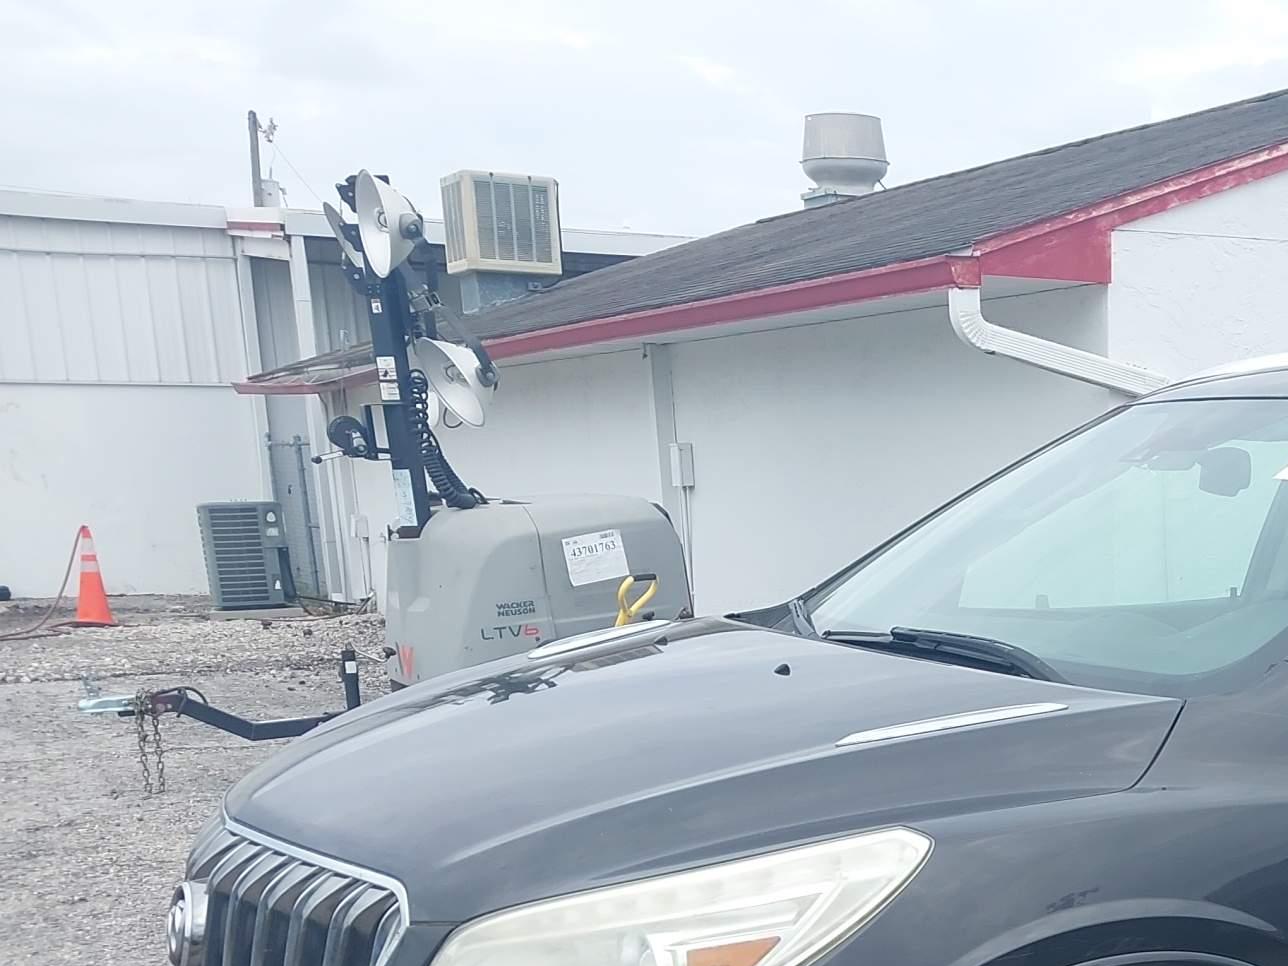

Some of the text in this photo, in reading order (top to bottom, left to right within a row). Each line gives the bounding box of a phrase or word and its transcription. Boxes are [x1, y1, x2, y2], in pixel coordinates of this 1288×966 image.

[570, 540, 617, 558] 43701763
[496, 600, 535, 611] WACKER
[497, 607, 536, 617] NEUSON
[480, 624, 539, 641] LTV6
